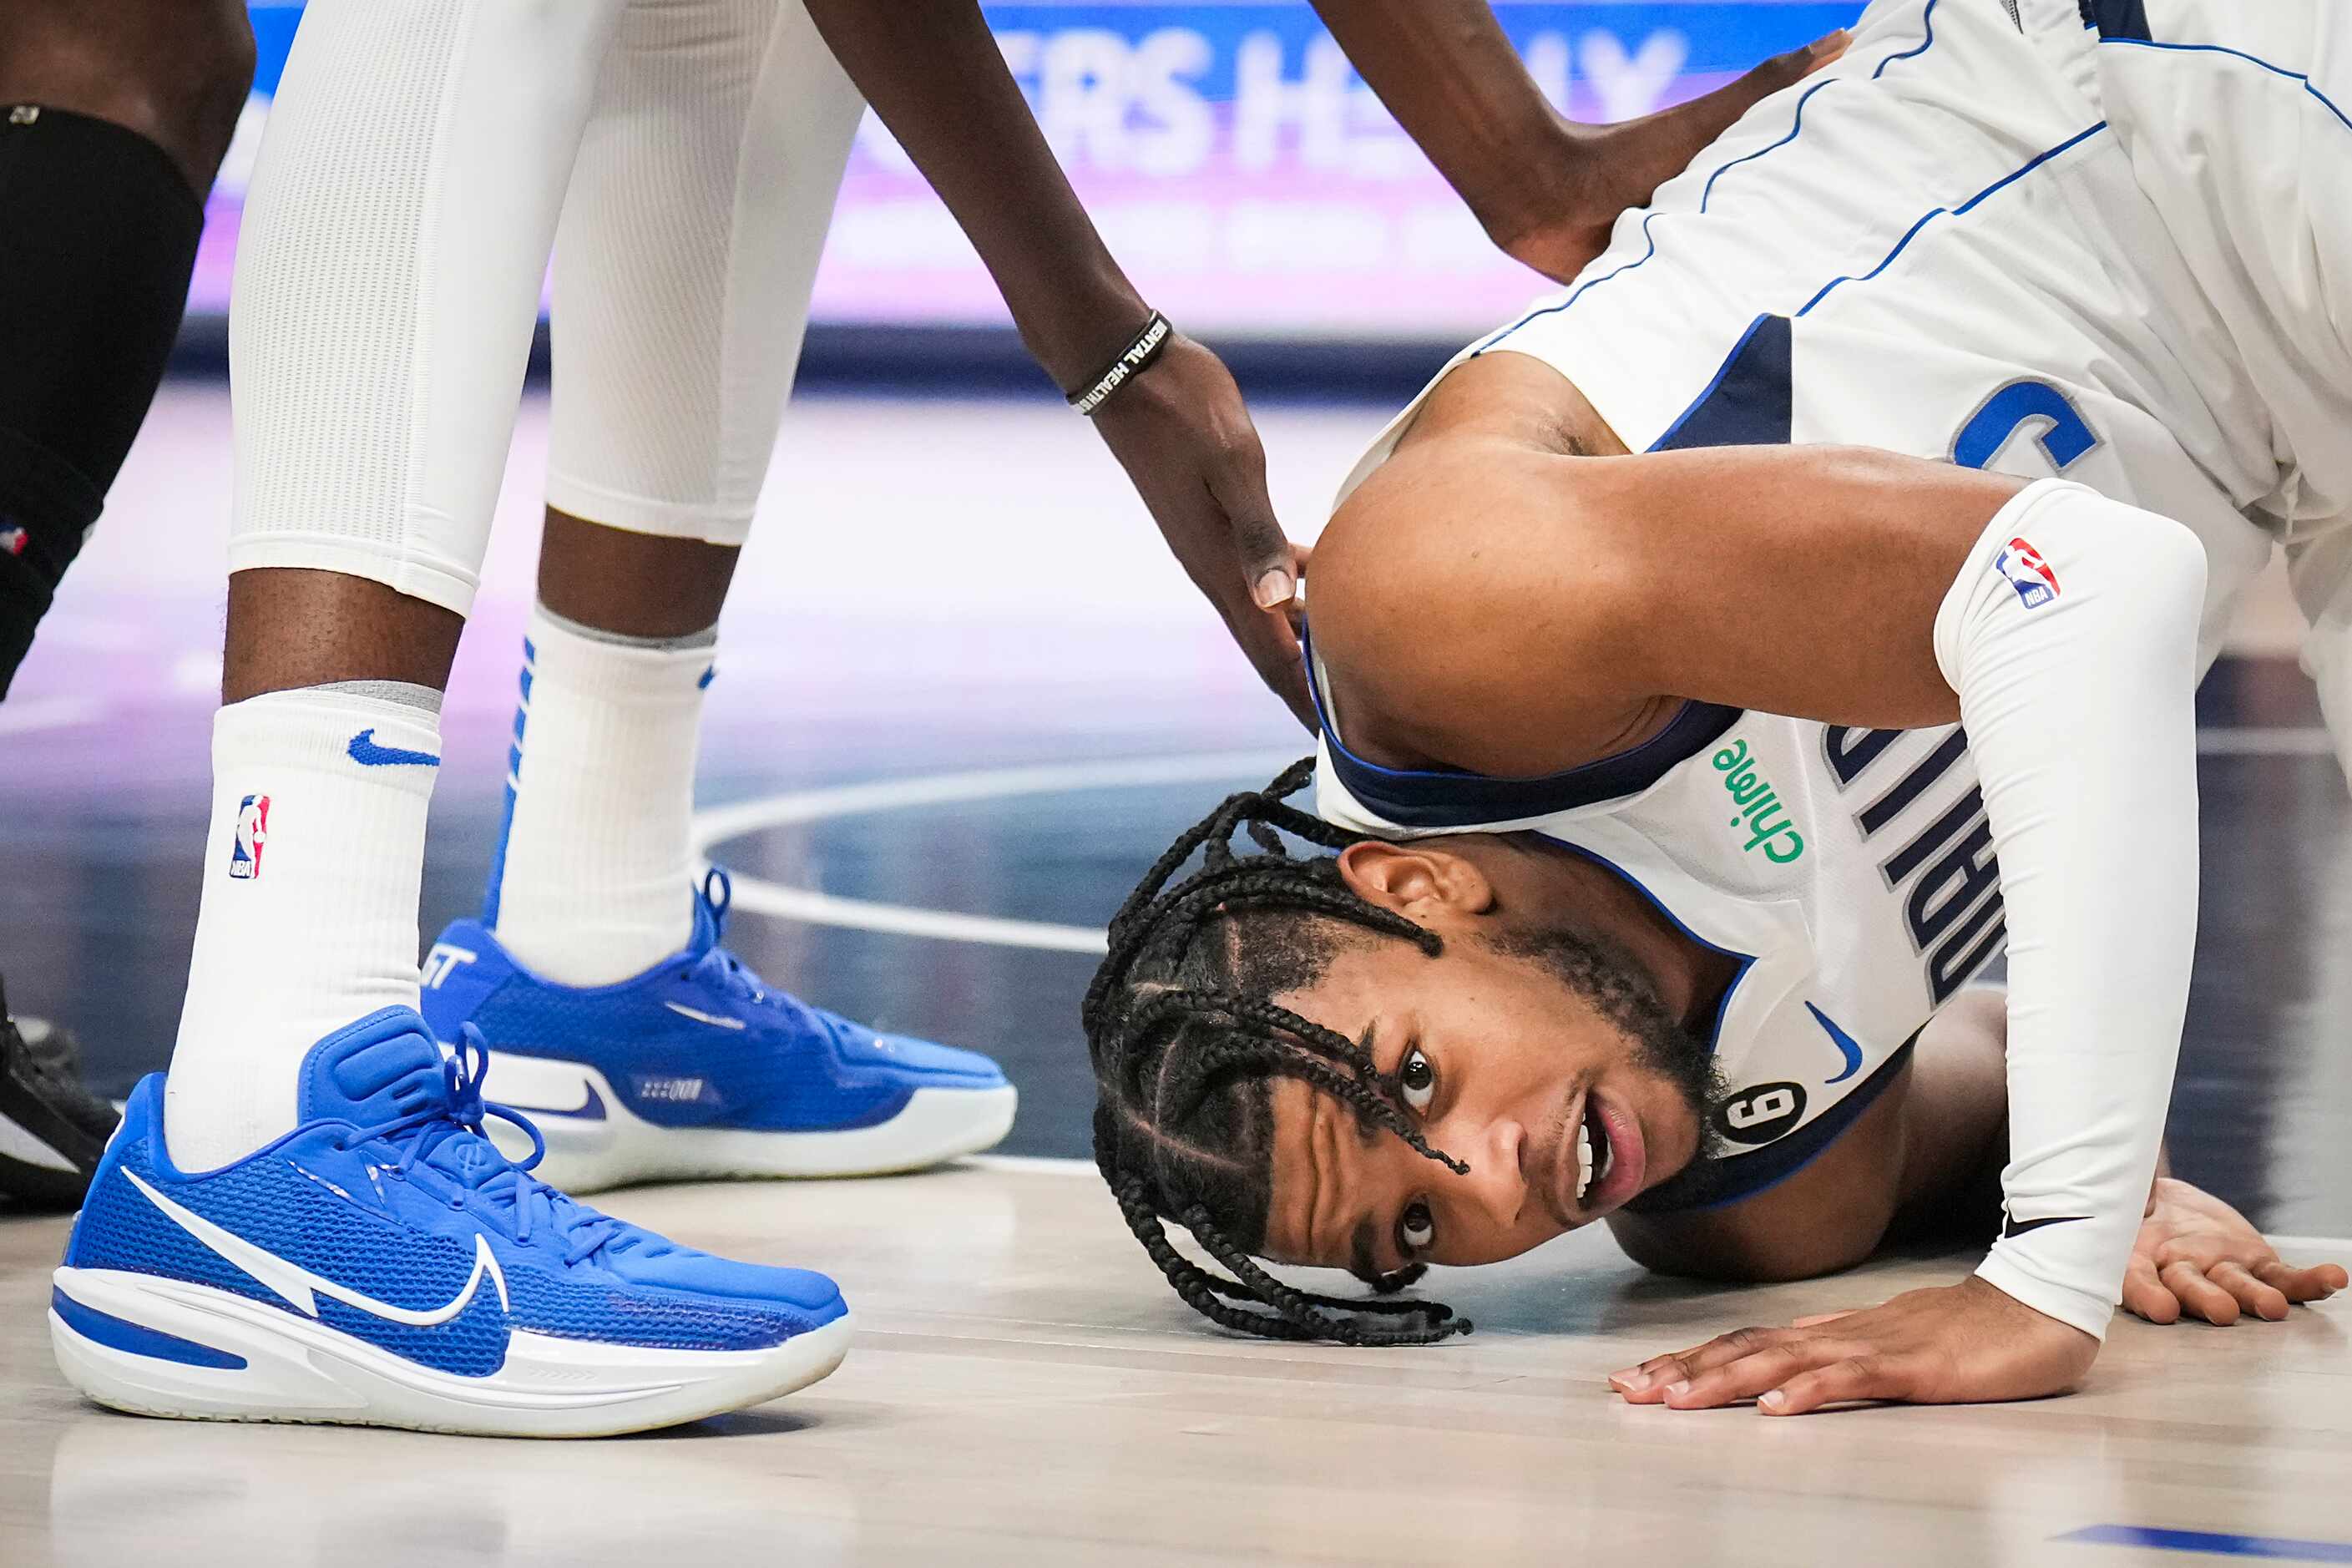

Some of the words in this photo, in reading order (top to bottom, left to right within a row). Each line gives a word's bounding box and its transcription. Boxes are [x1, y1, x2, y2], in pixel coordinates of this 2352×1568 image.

[1085, 362, 1130, 405] HEALTH
[2025, 586, 2048, 606] NBA
[1712, 739, 1803, 863] chime
[231, 859, 251, 877] NBA
[1727, 1088, 1795, 1129] 6
